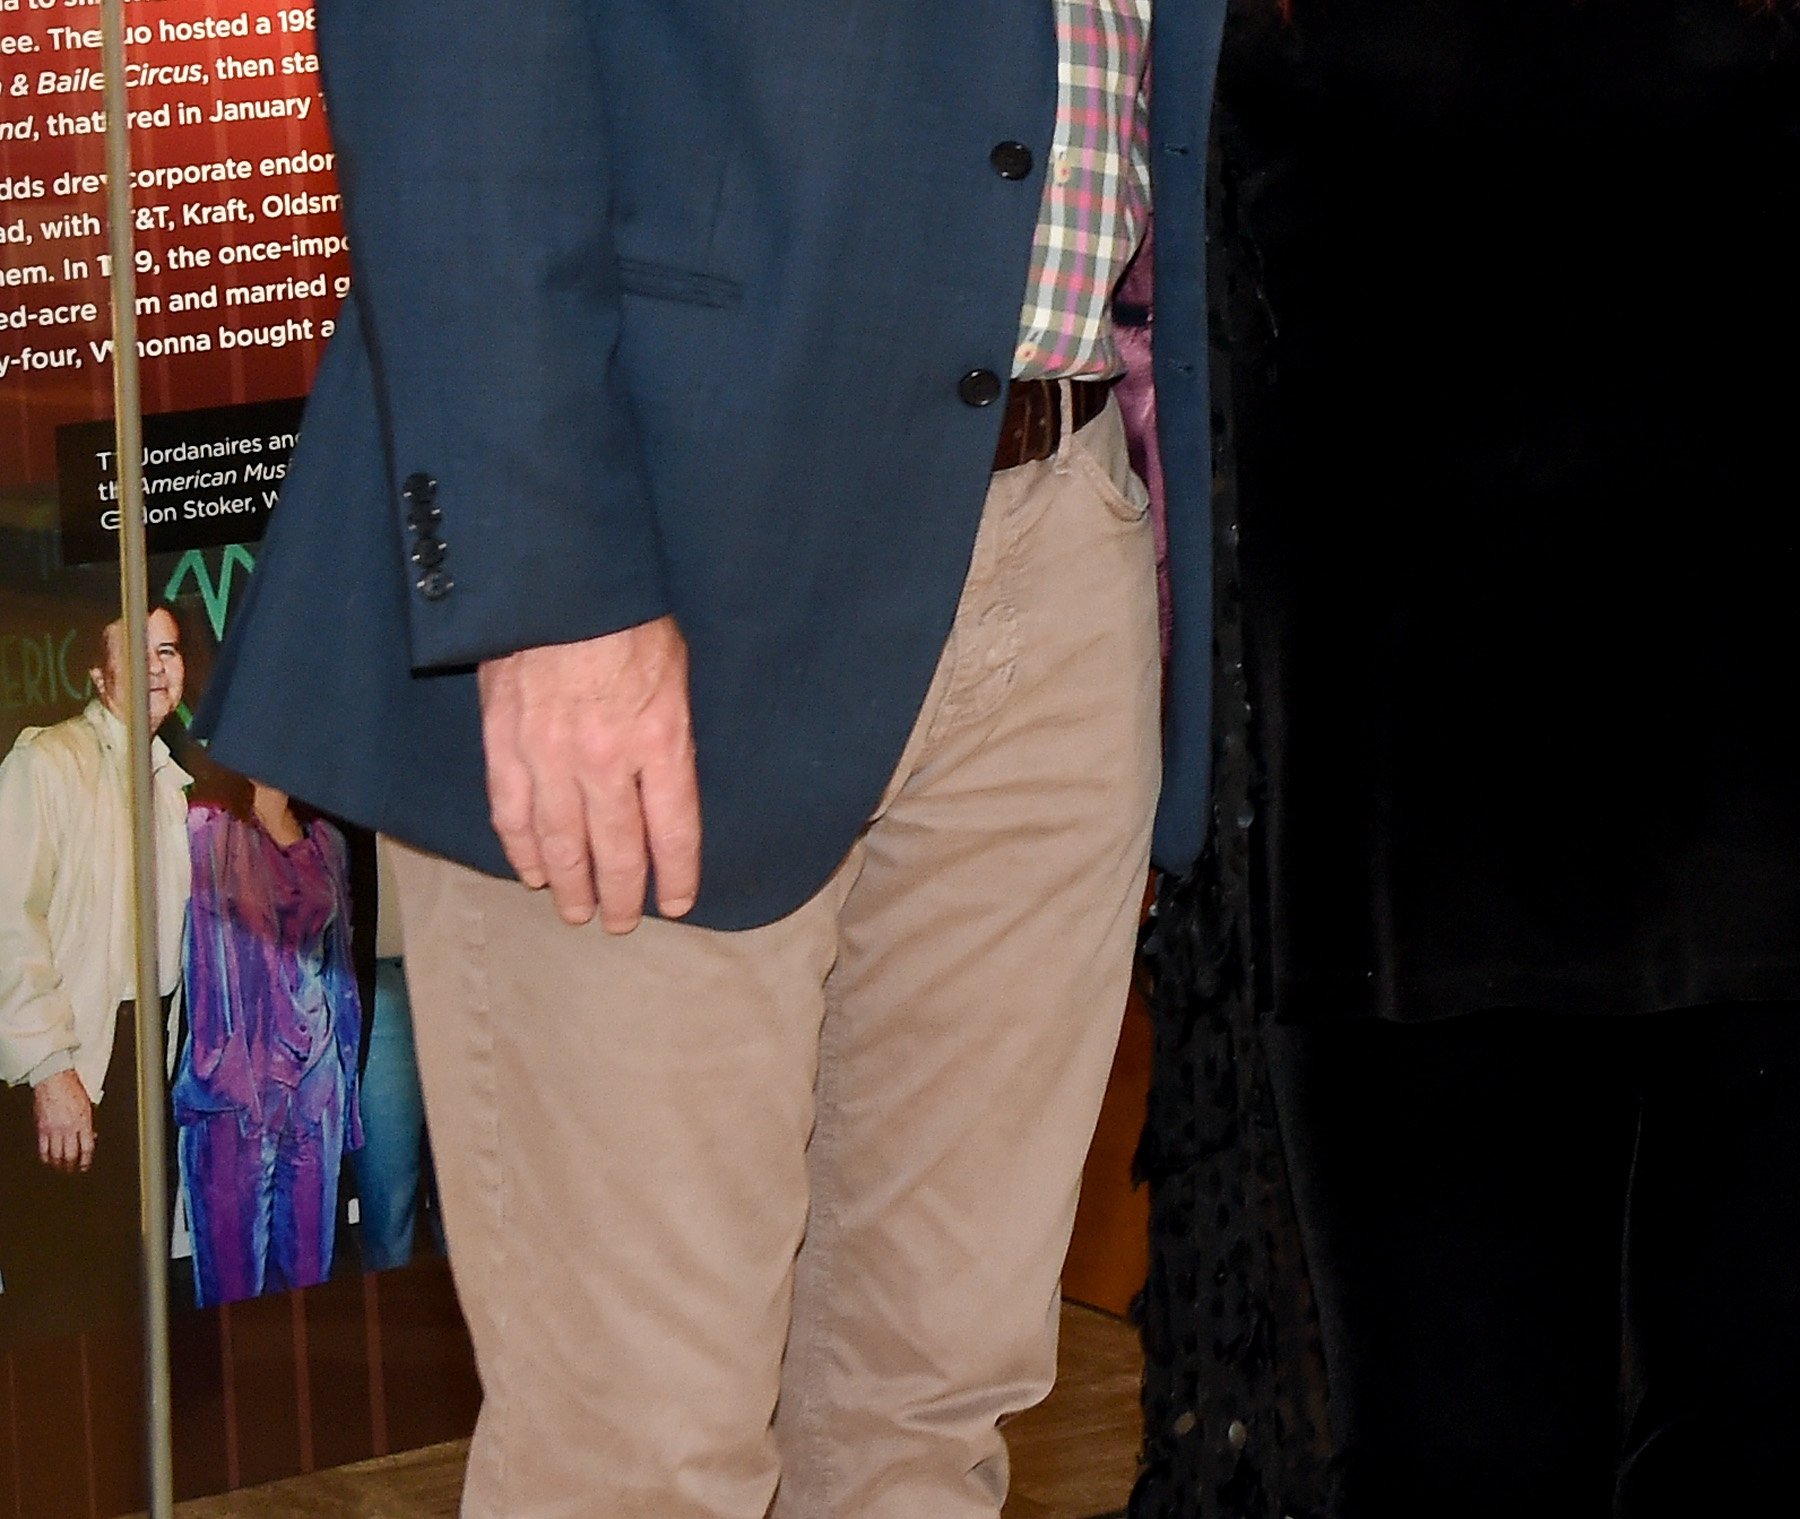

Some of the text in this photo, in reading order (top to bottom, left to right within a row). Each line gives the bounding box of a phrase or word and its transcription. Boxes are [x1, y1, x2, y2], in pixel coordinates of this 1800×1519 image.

[159, 13, 248, 42] hosted
[255, 16, 271, 35] a
[10, 74, 29, 96] &
[215, 56, 275, 80] then
[178, 100, 202, 125] in
[209, 96, 311, 123] January
[40, 213, 100, 239] with
[182, 198, 255, 226] Kraft,
[64, 258, 88, 280] In
[167, 245, 211, 270] the
[168, 285, 218, 313] and
[225, 273, 326, 307] married
[219, 318, 314, 348] bought
[141, 436, 263, 466] Jordanaires
[183, 496, 256, 520] Stoker,
